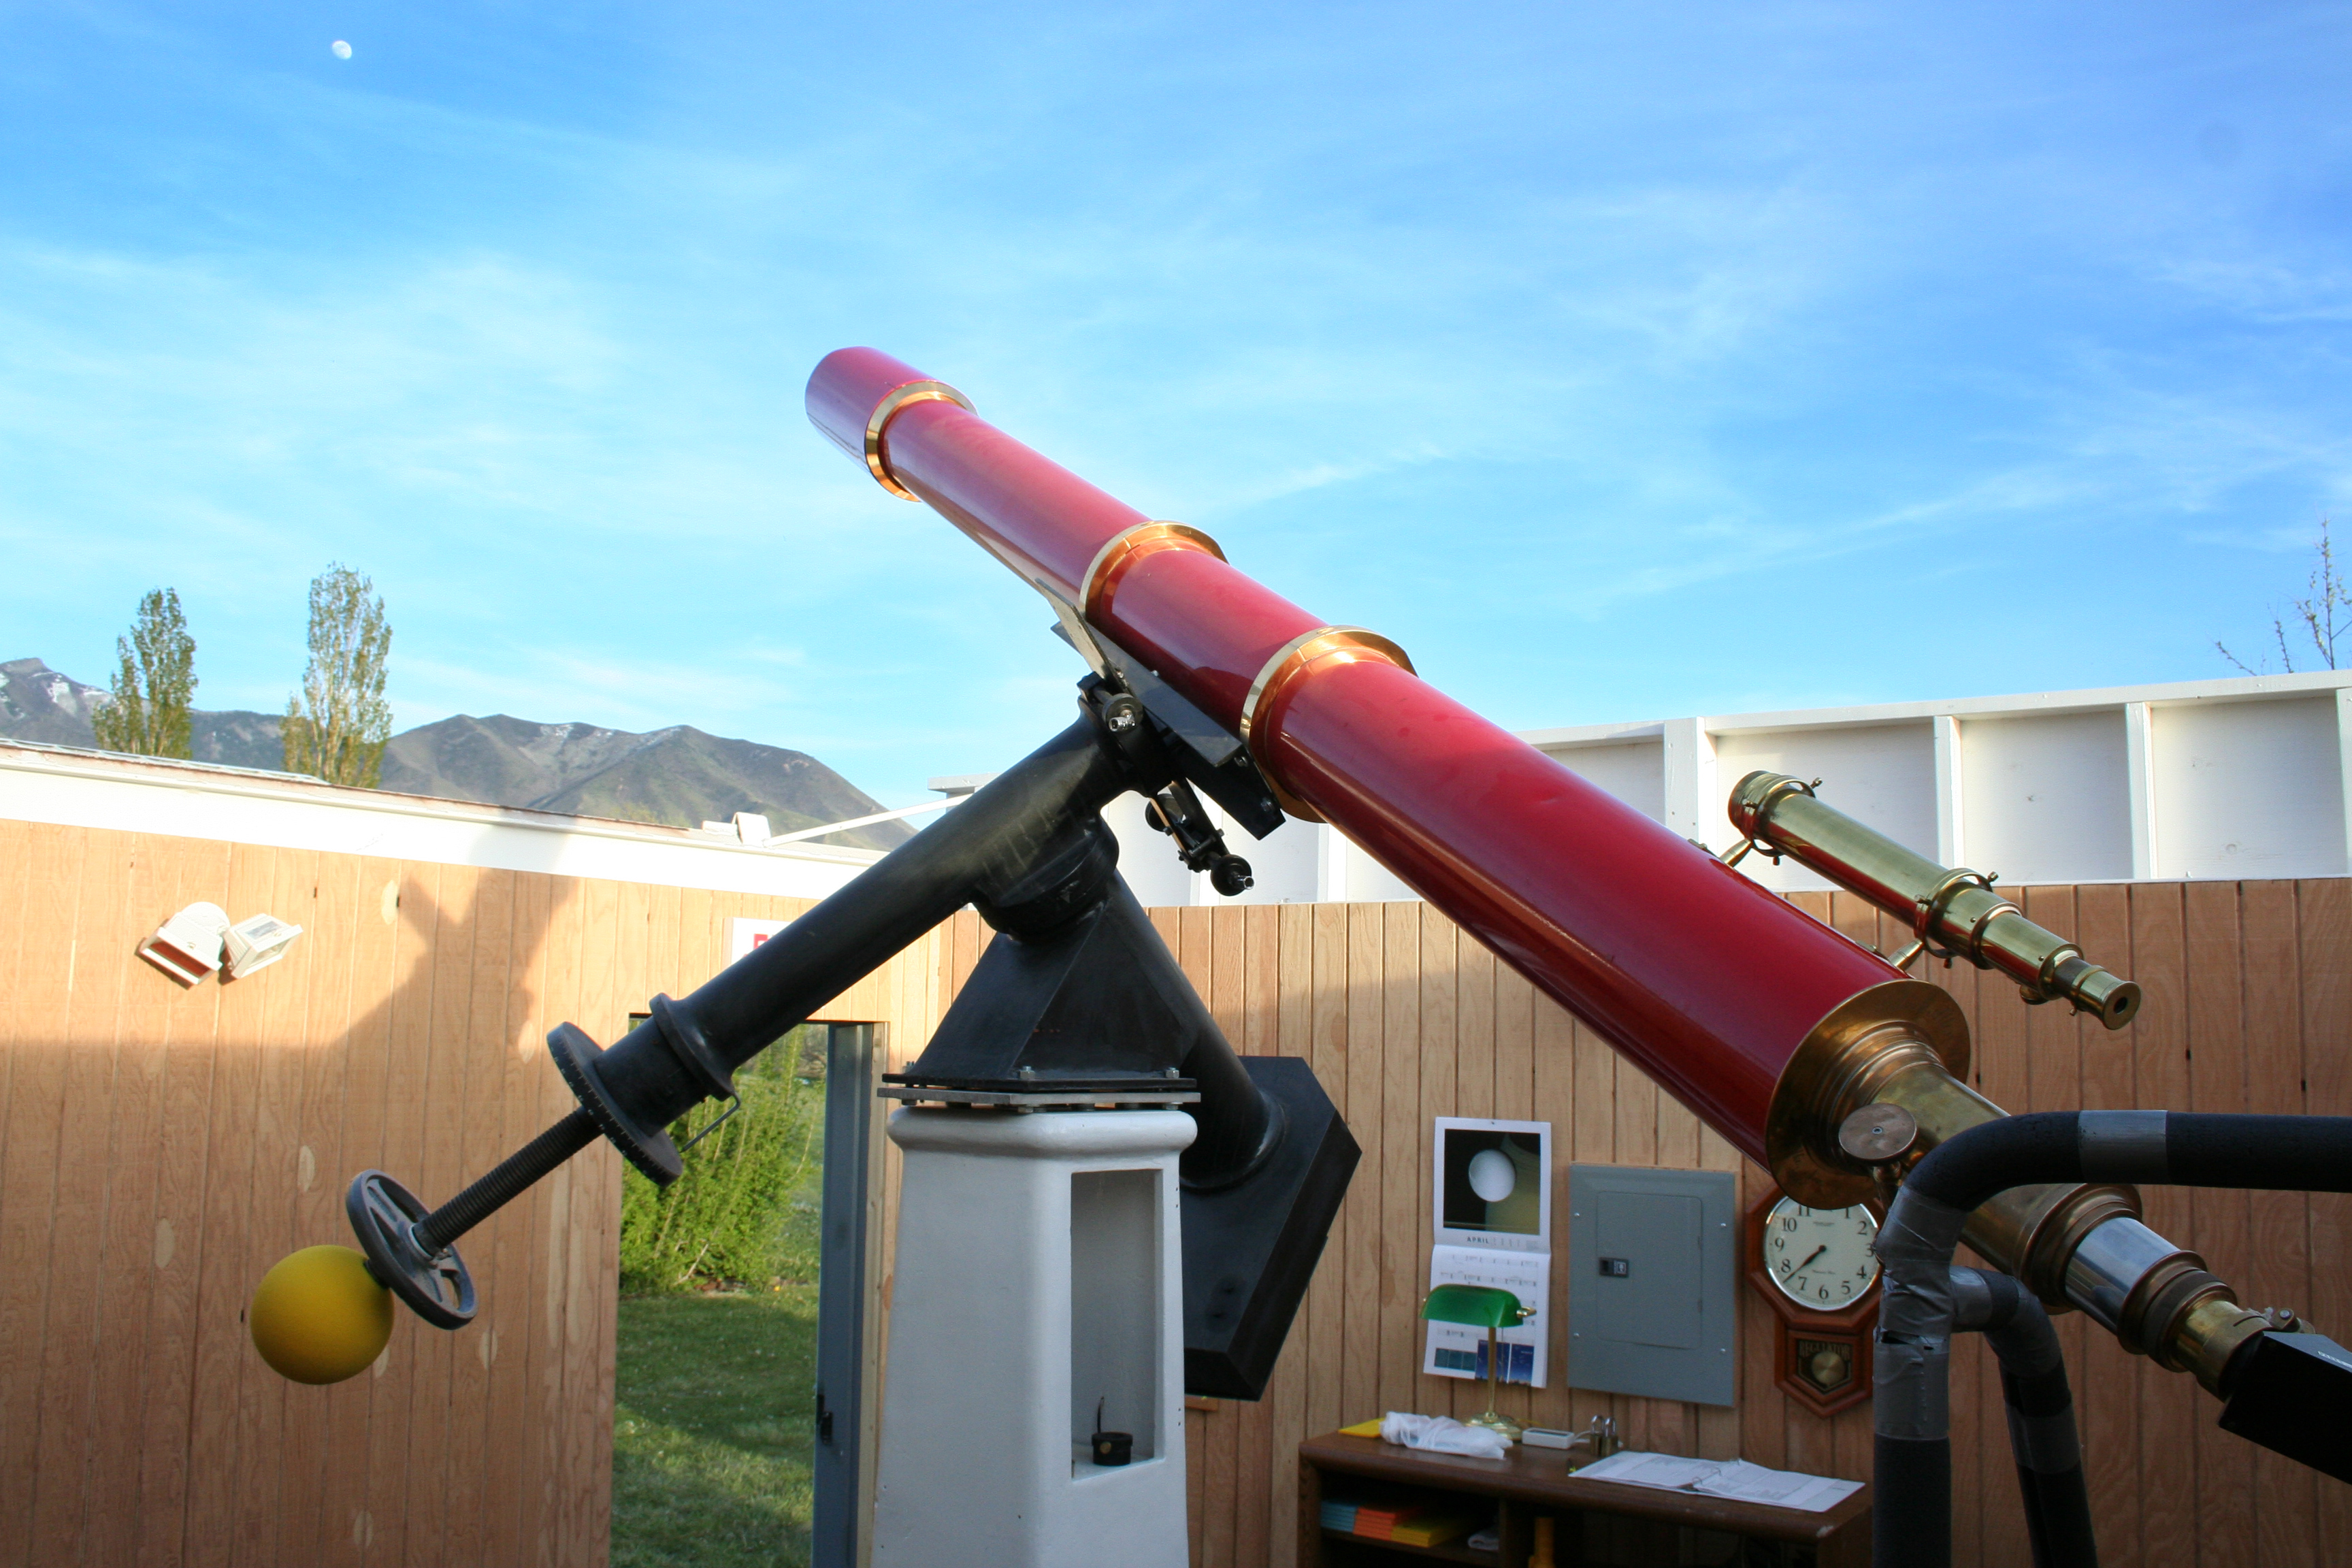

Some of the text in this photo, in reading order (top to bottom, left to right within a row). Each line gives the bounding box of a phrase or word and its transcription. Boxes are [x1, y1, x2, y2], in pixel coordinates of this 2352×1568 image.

[1797, 1205, 1810, 1217] 11
[1782, 1217, 1797, 1232] 10
[1857, 1220, 1867, 1235] 2
[1775, 1237, 1784, 1252] 9
[1865, 1243, 1874, 1257] 3
[1780, 1258, 1791, 1273] 8
[1856, 1264, 1867, 1279] 4
[1797, 1275, 1808, 1290] 7
[1840, 1280, 1850, 1294] 5
[1818, 1284, 1829, 1300] 6
